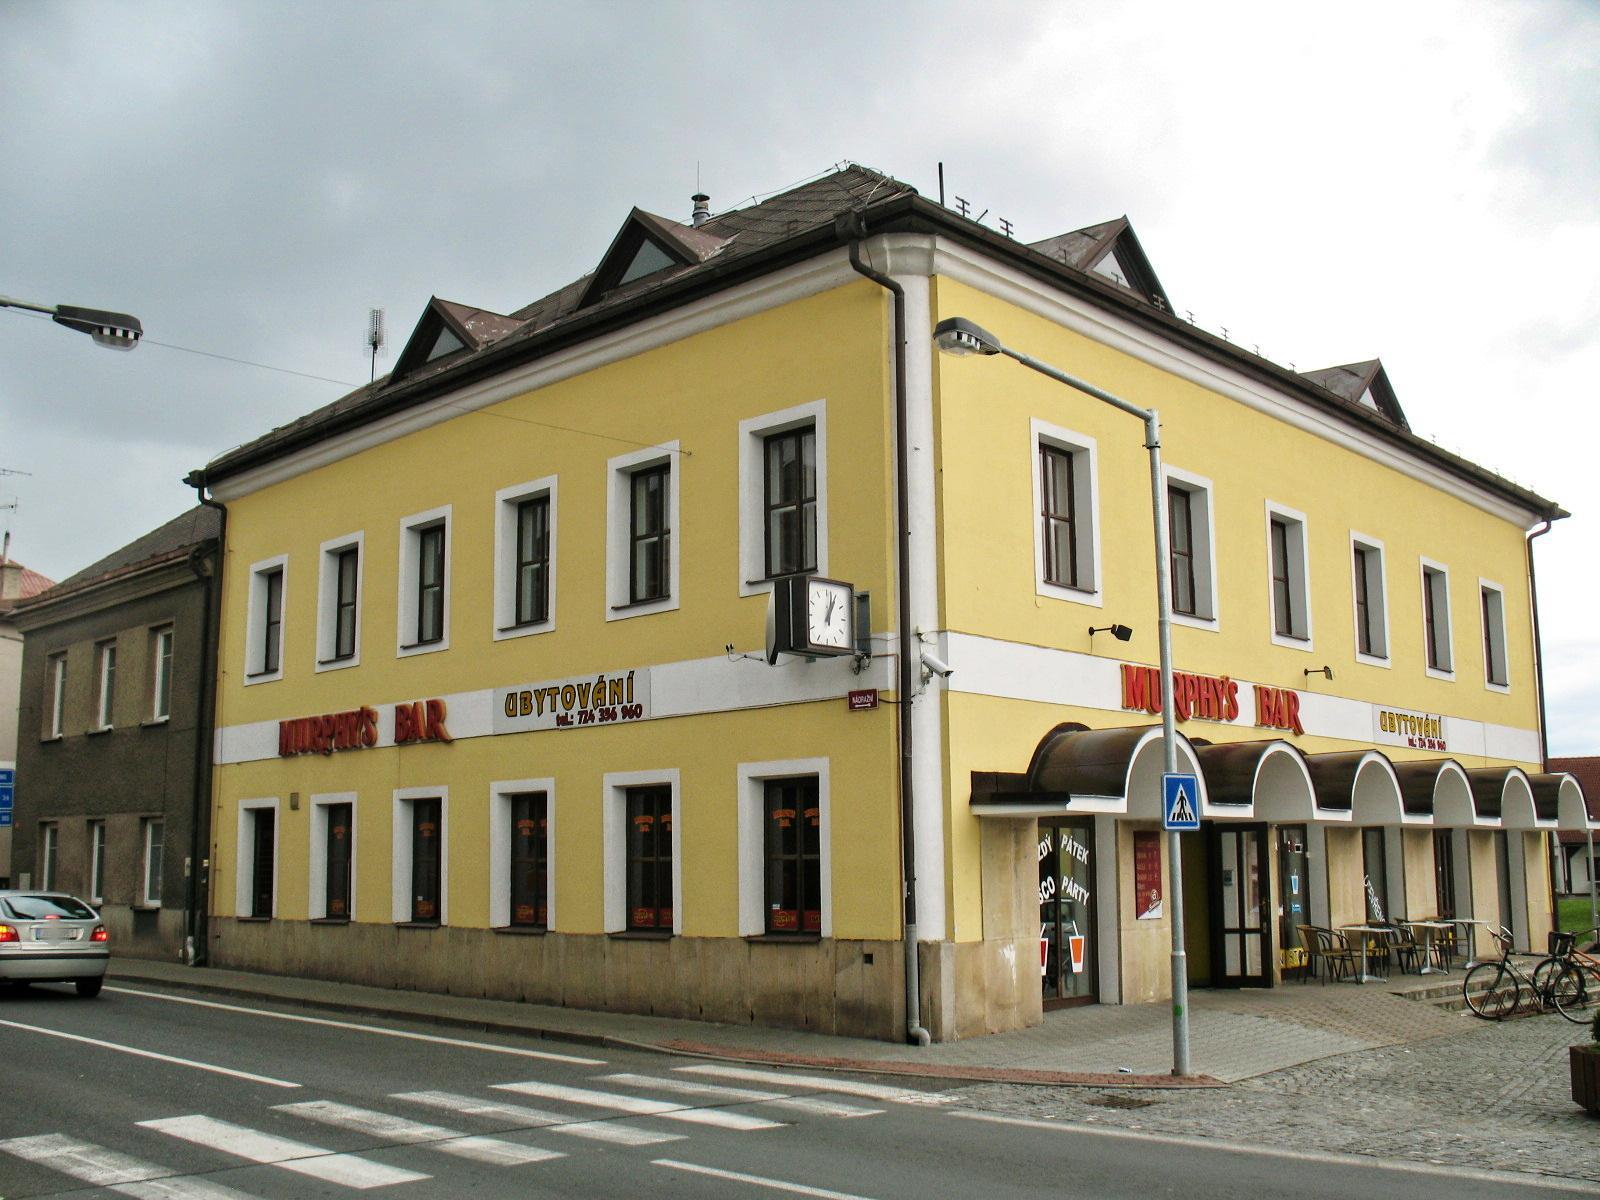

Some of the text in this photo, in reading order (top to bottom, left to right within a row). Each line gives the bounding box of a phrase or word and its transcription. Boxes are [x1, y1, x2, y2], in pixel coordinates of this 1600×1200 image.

[505, 671, 635, 719] UBYTOVÁNÍ
[1120, 664, 1305, 736] MURPHY'S BAR
[621, 703, 643, 720] 960
[1379, 710, 1442, 739] UBYTOVÁNÍ
[279, 699, 454, 757] MURPHY'S BAR
[1061, 833, 1090, 865] PÁTEK
[1061, 875, 1090, 906] PÁRTY
